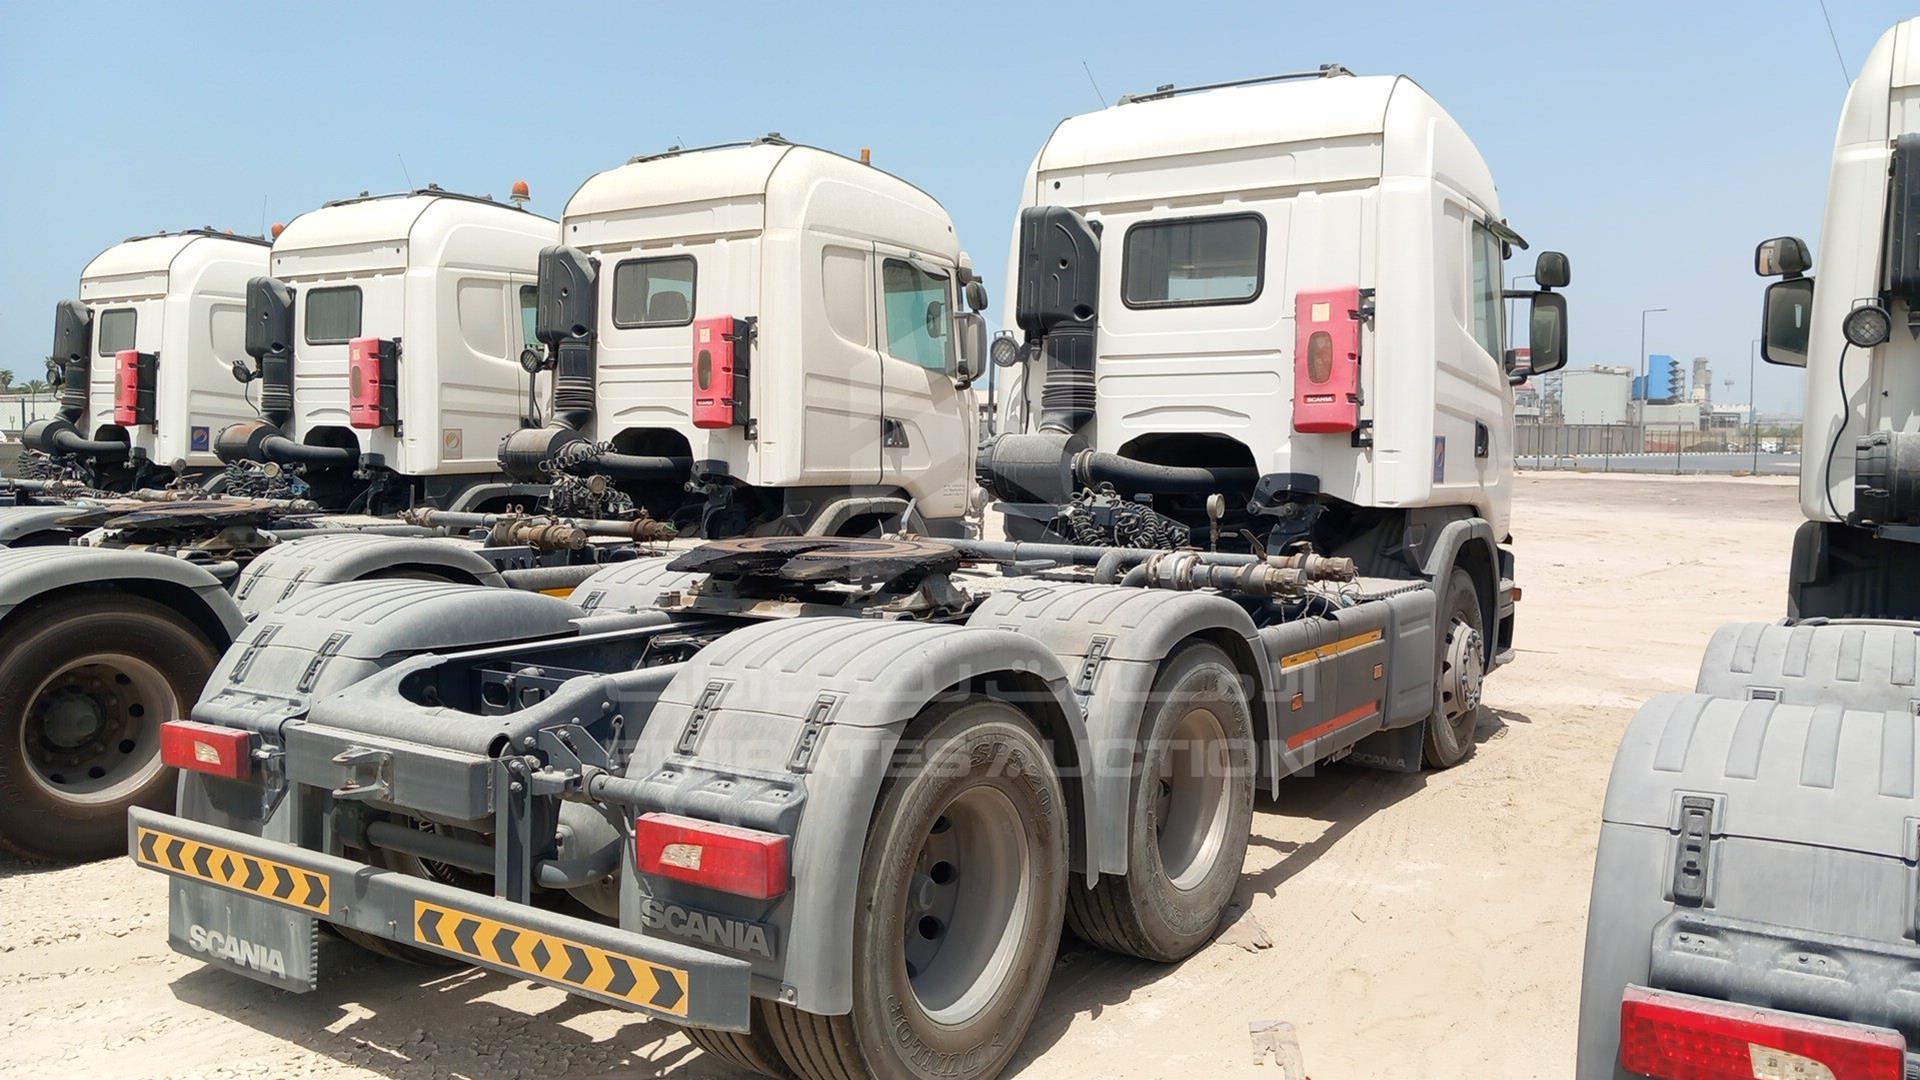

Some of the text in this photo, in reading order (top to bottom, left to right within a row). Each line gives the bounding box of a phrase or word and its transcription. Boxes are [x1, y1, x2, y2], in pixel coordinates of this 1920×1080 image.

[1351, 752, 1406, 768] SCANIA
[188, 924, 287, 979] SCANIA
[640, 900, 770, 957] SCANIA
